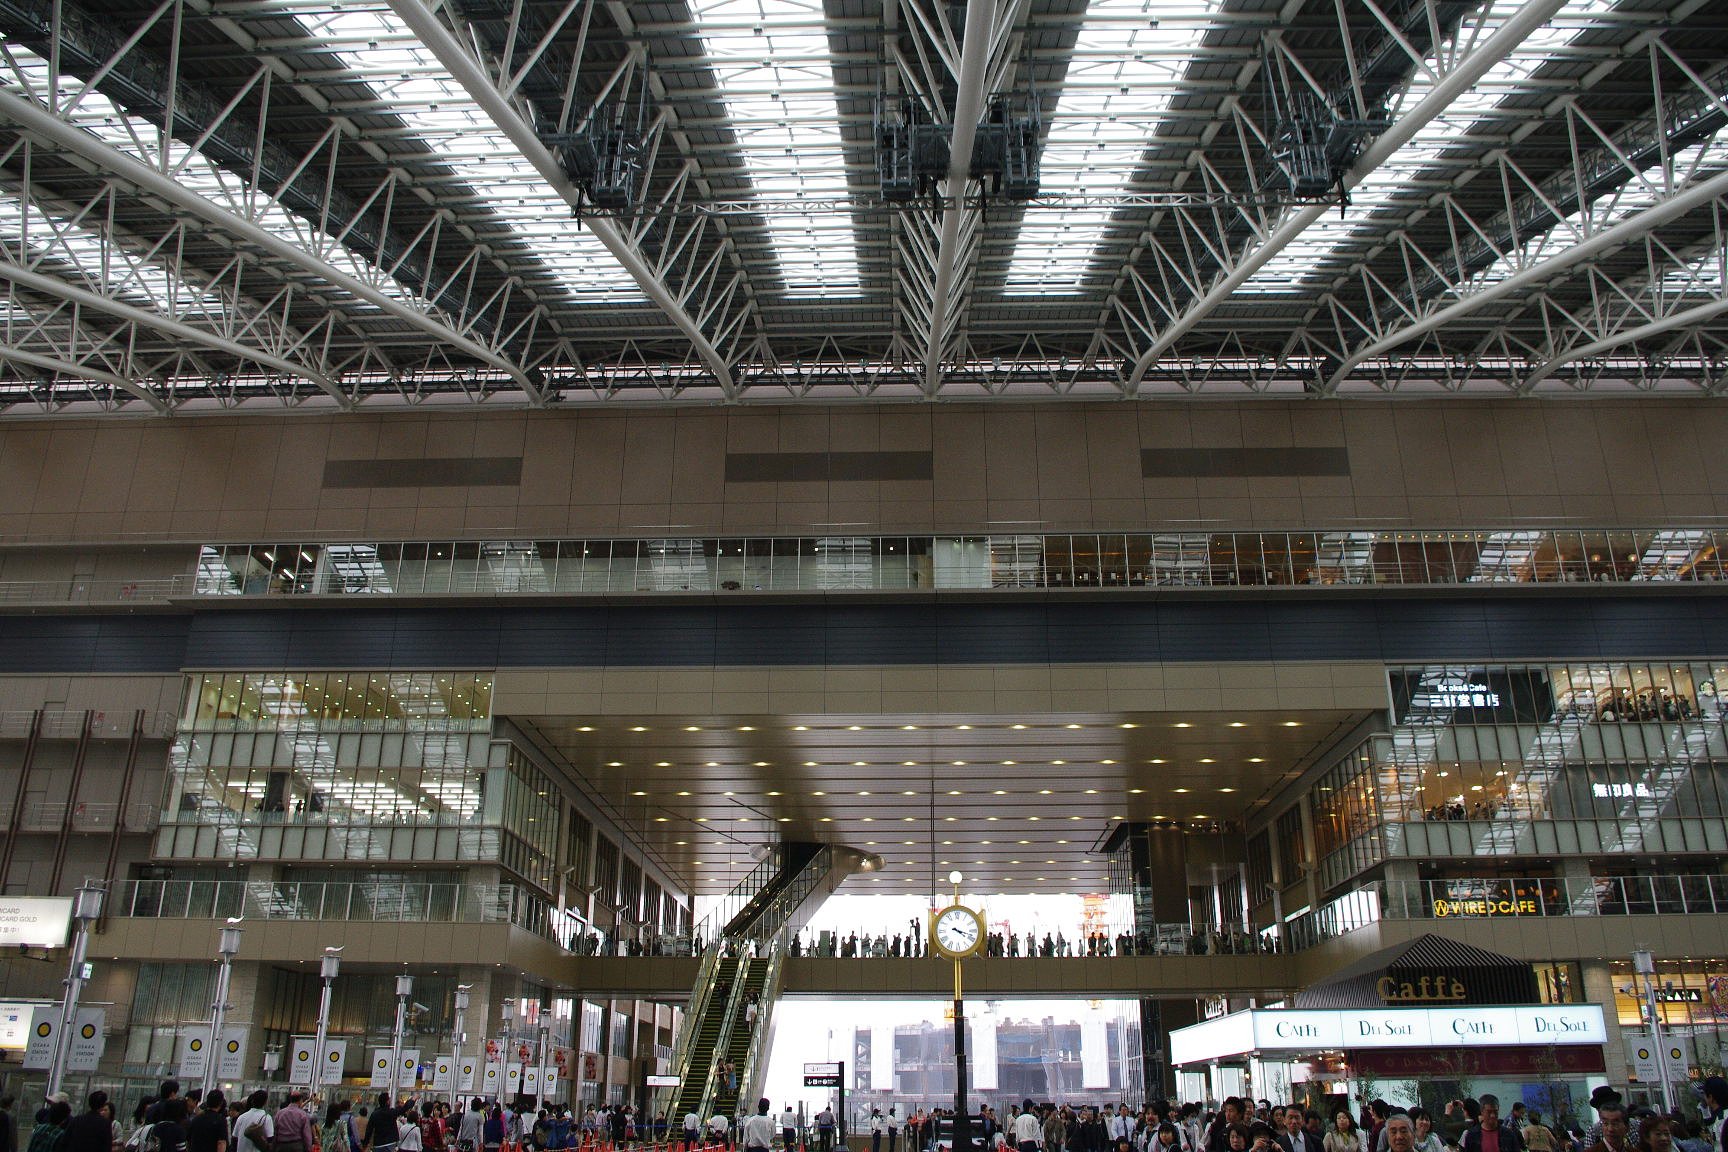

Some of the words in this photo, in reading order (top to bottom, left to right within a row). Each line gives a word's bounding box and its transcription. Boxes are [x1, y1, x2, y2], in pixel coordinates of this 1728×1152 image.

[1592, 782, 1650, 798] 無印良品
[1450, 900, 1497, 914] WIRED
[1499, 900, 1536, 914] CAFE
[1376, 976, 1467, 1001] Caffè
